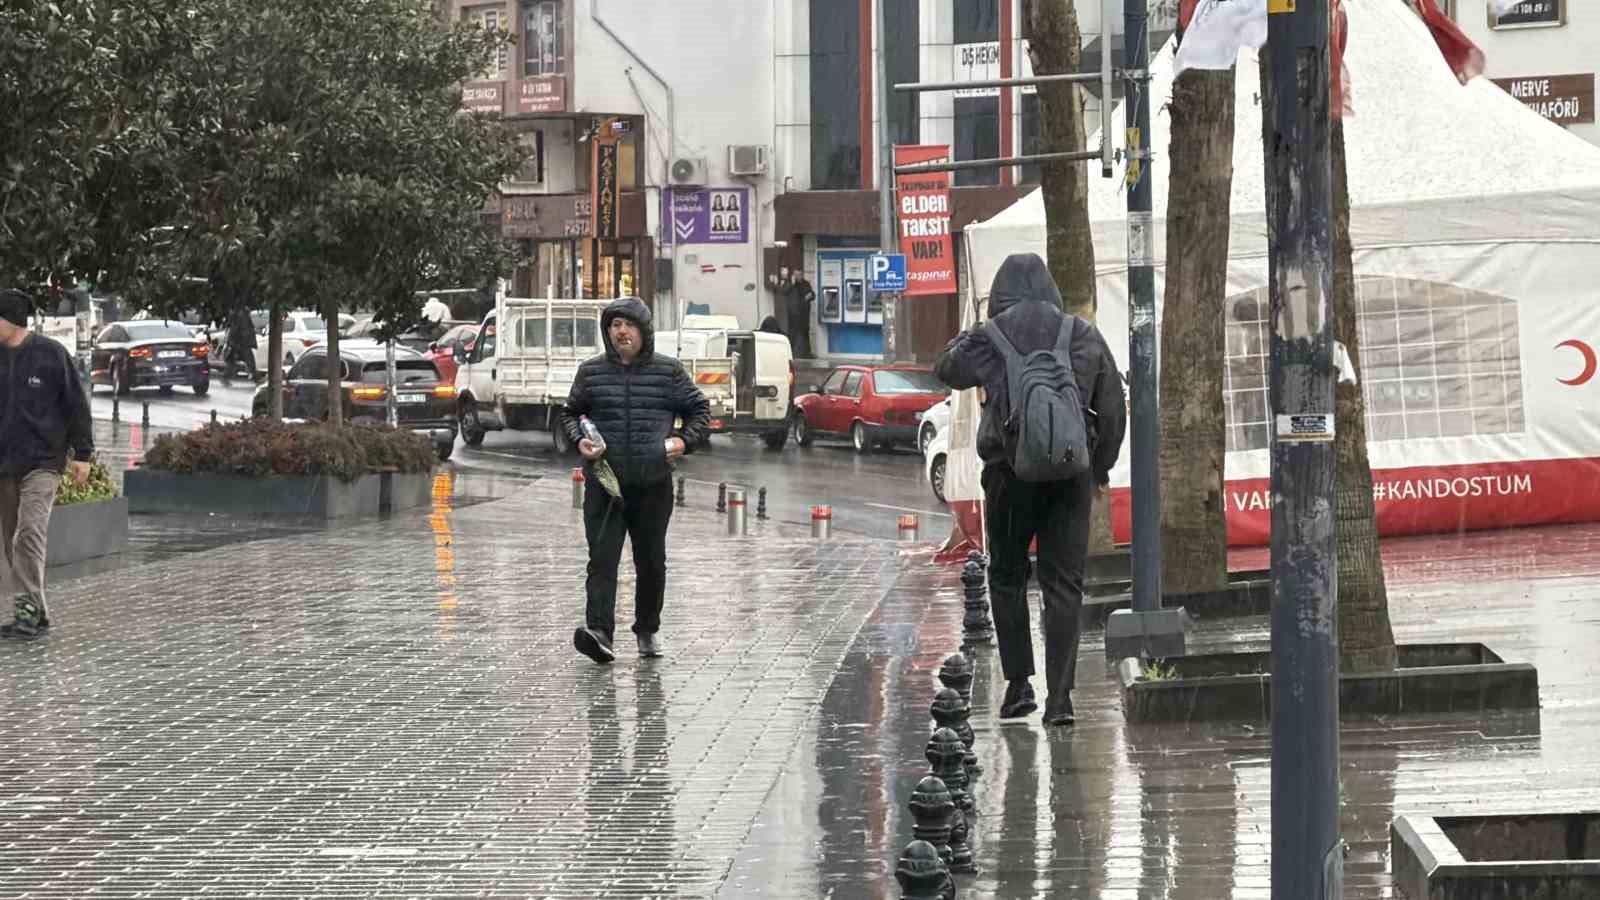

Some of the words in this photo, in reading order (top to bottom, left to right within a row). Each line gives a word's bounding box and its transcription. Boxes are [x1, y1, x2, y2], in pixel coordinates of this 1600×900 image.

[1511, 80, 1549, 97] MERVE
[911, 239, 943, 259] VAR!
[873, 256, 890, 281] P
[1372, 474, 1533, 500] #KANDOSTUM
